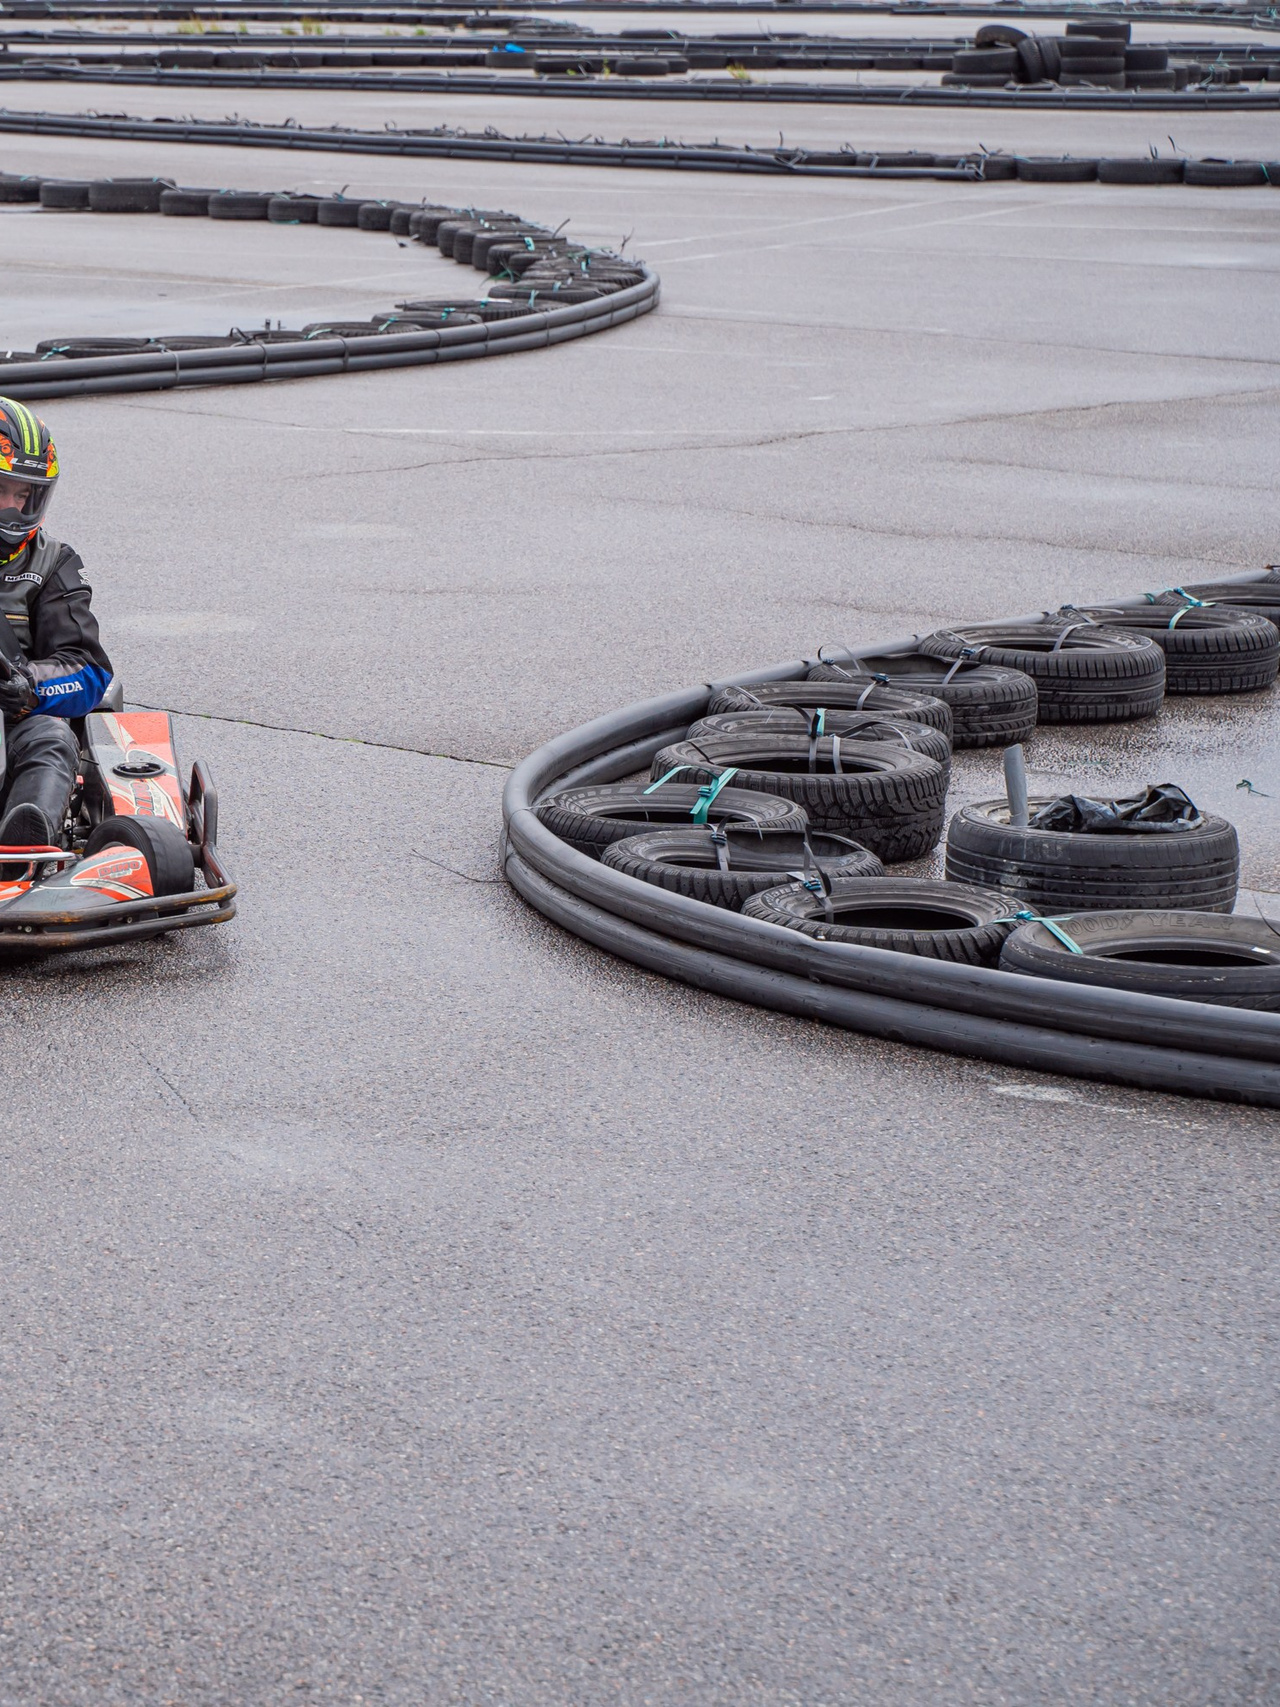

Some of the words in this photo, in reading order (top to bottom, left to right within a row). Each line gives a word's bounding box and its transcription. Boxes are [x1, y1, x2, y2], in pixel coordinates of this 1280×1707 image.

[10, 457, 48, 470] LS2
[6, 573, 41, 584] MEMBER
[98, 861, 141, 877] DINO
[1145, 911, 1235, 931] YEAR
